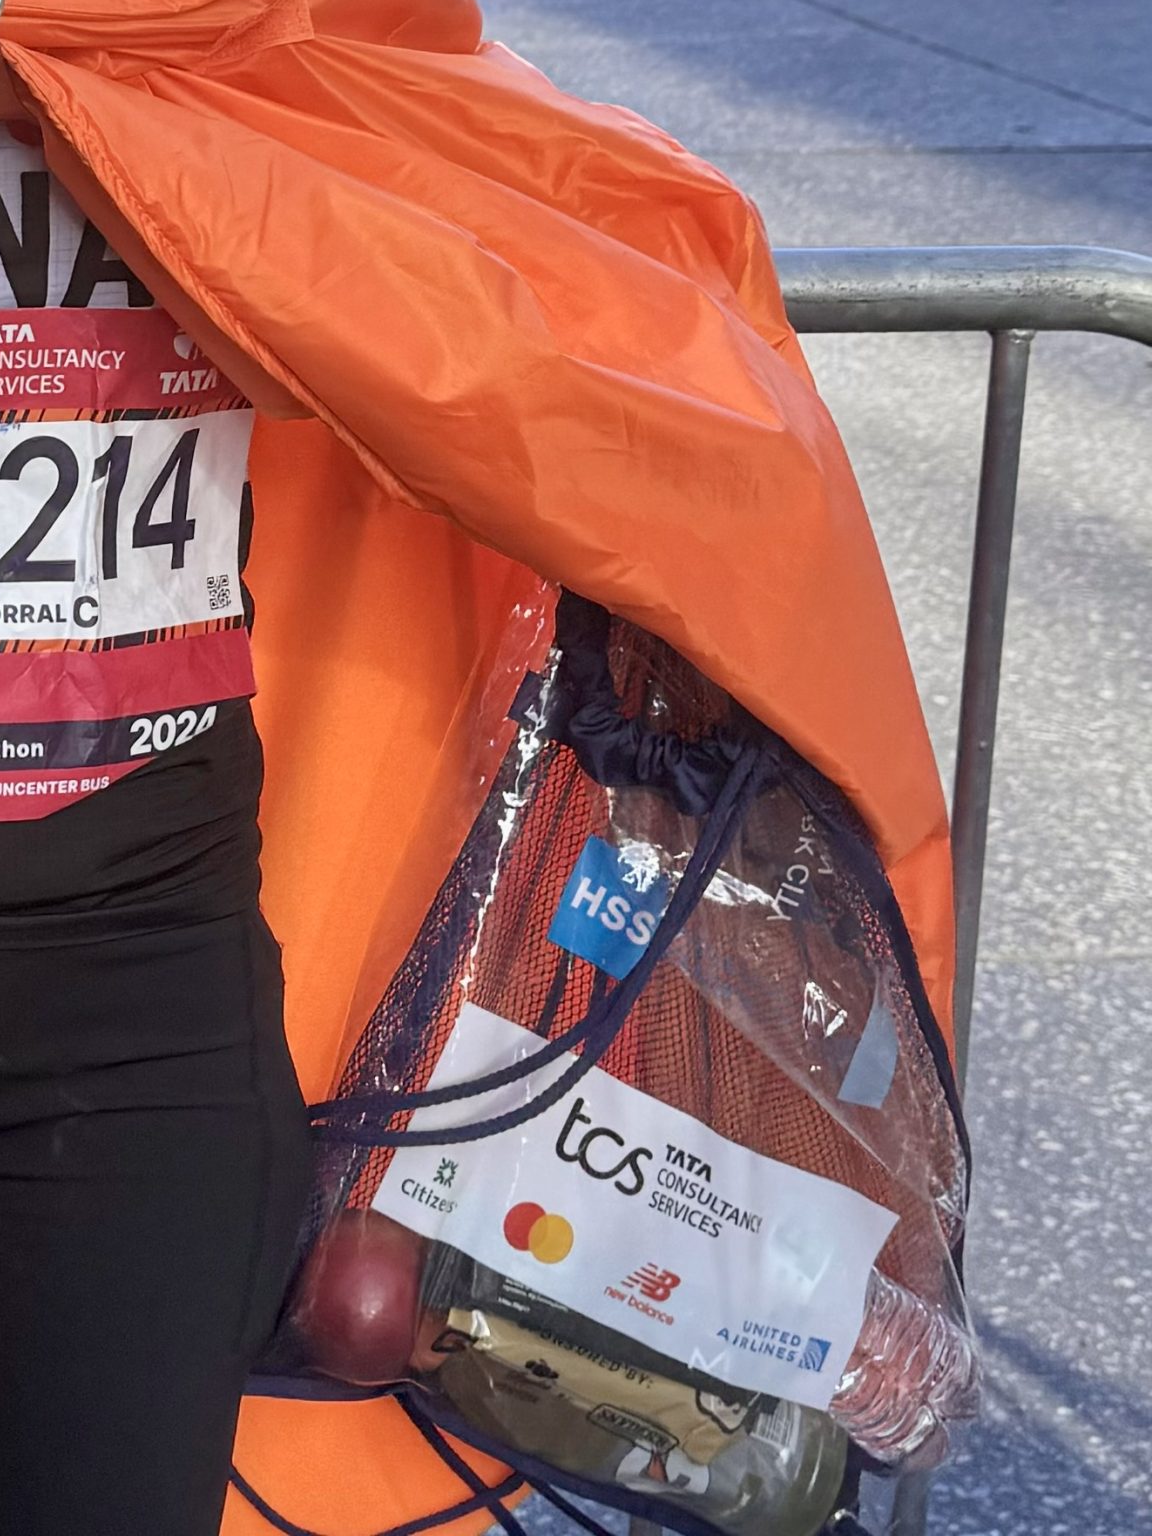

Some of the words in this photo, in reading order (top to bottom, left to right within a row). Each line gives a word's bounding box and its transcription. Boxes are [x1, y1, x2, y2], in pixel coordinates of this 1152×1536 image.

[159, 367, 219, 395] TATA
[73, 595, 99, 629] C
[130, 706, 217, 756] 2024
[80, 776, 110, 791] BUS
[571, 876, 656, 946] HSS
[766, 864, 810, 921] CITY
[556, 1097, 653, 1196] tcs
[666, 1144, 712, 1183] TATA
[401, 1178, 454, 1214] Citizes
[648, 1190, 723, 1239] SERVICES
[603, 1285, 627, 1302] new
[627, 1294, 675, 1326] balance
[716, 1327, 799, 1362] AIRLINES
[742, 1320, 801, 1346] UNITED
